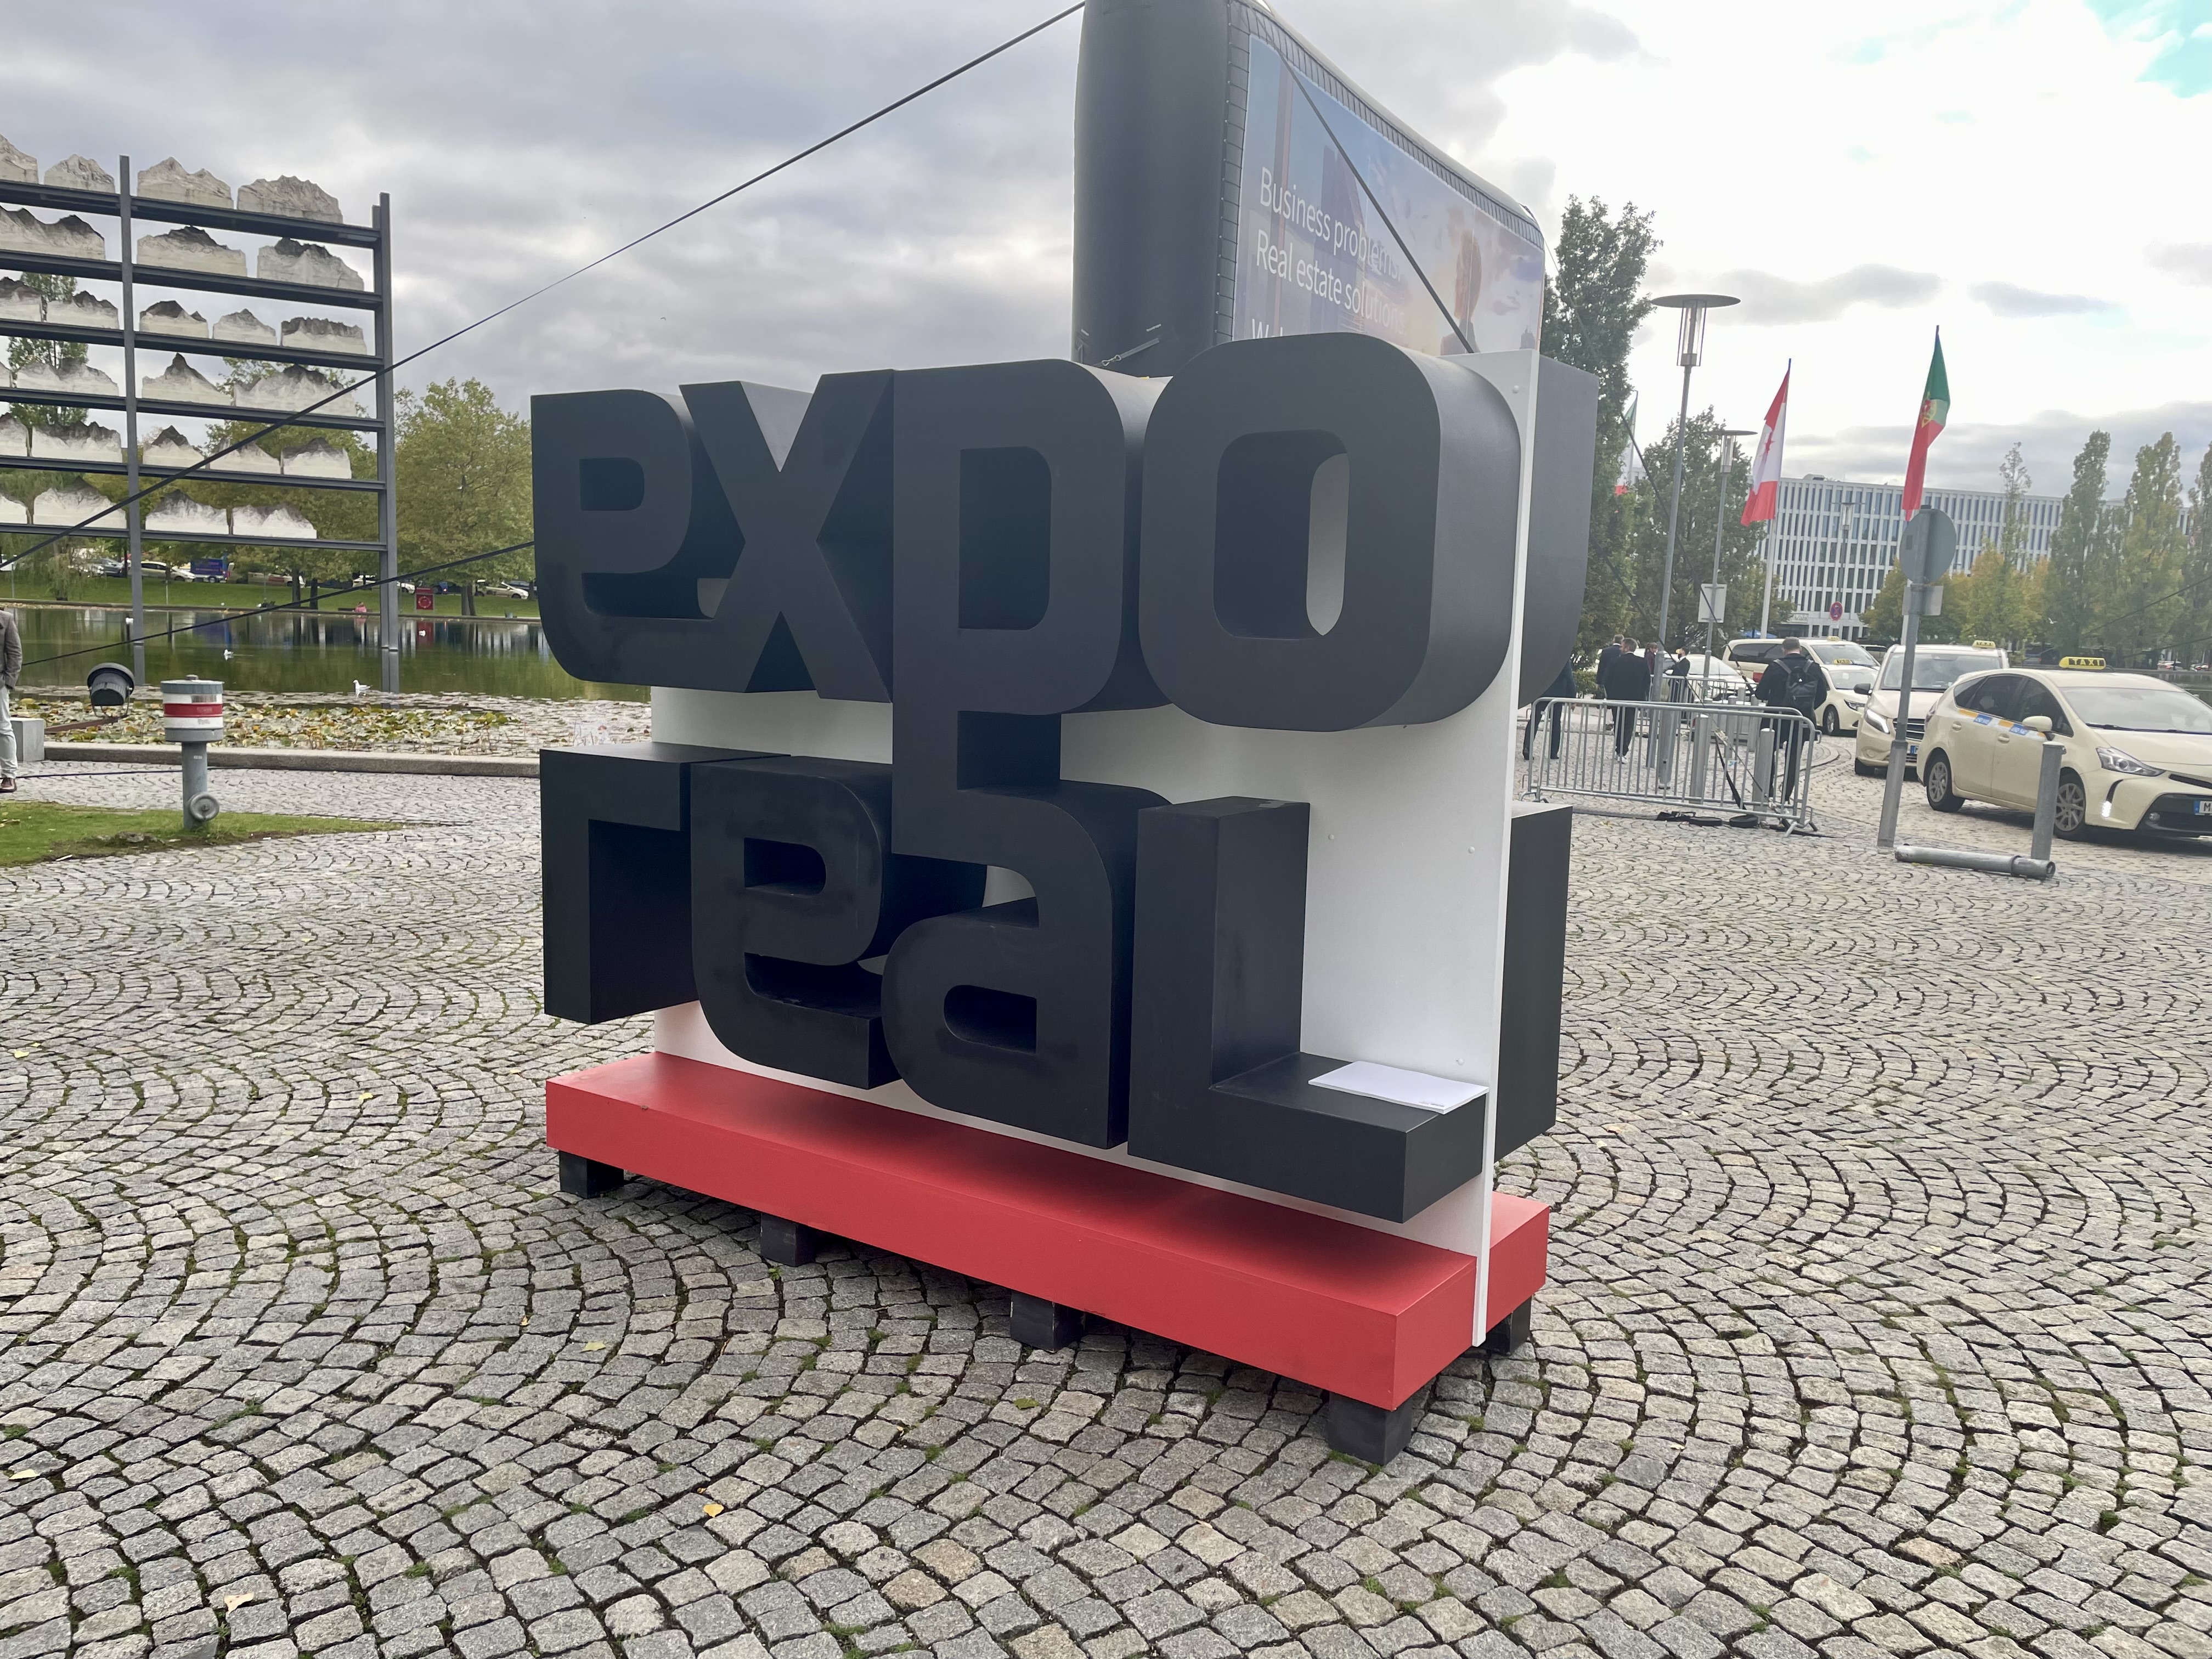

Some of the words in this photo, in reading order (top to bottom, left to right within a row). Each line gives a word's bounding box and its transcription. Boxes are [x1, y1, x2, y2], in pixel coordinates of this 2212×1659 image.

[1260, 166, 1330, 241] Business
[1257, 229, 1293, 283] Real
[1296, 259, 1342, 305] estate
[2072, 658, 2101, 666] TAXI
